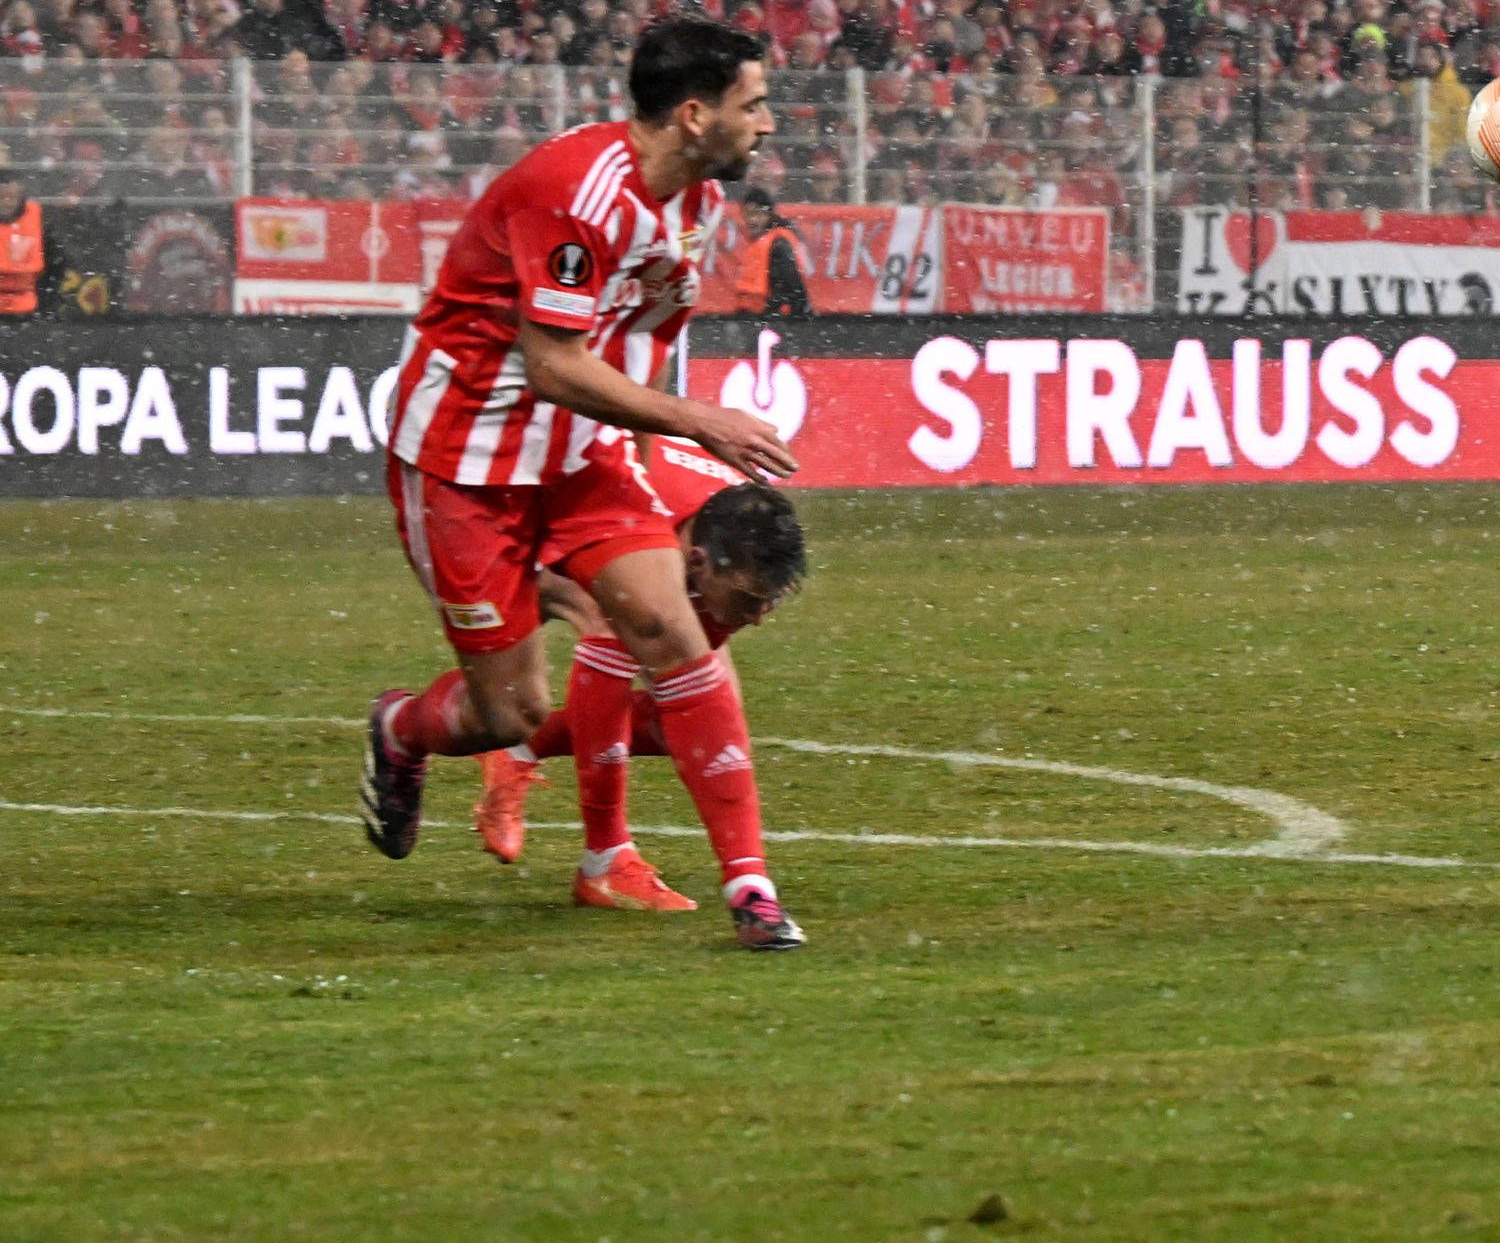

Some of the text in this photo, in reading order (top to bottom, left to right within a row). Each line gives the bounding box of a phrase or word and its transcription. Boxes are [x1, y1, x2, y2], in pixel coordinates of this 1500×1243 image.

[882, 251, 933, 300] 82
[0, 365, 189, 455] OPA
[909, 335, 1459, 471] STRAUSS
